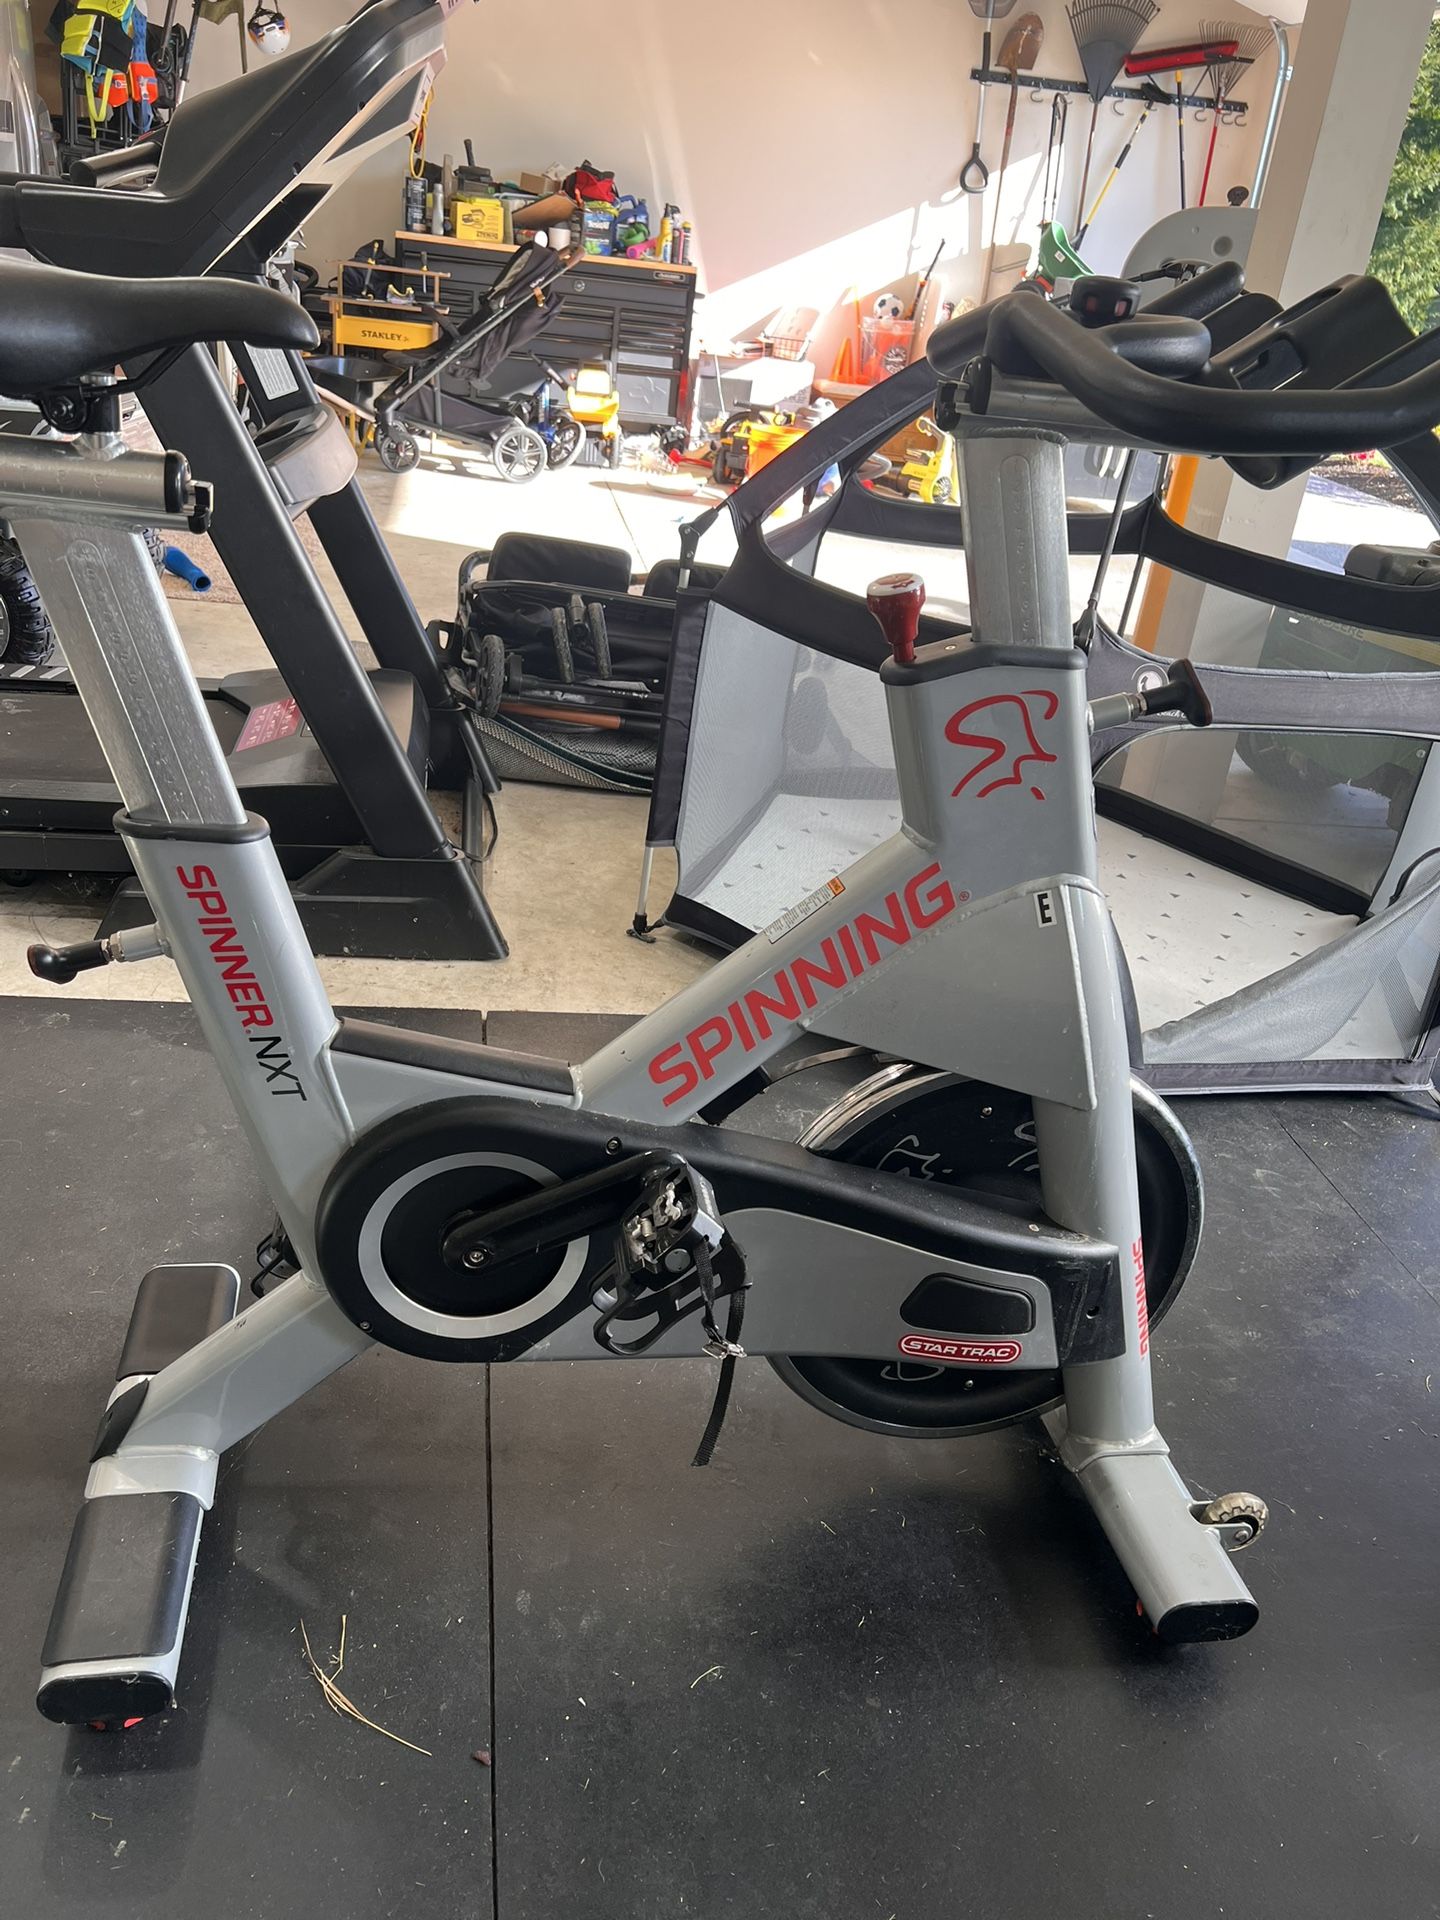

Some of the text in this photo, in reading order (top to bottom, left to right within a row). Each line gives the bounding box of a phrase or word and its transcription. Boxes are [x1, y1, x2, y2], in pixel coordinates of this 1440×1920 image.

[361, 330, 402, 341] STANLEY
[1037, 892, 1052, 924] E
[176, 864, 307, 1102] SPINNER NXT
[648, 863, 957, 1107] SPINNING
[906, 1340, 1011, 1358] STAR TRAC
